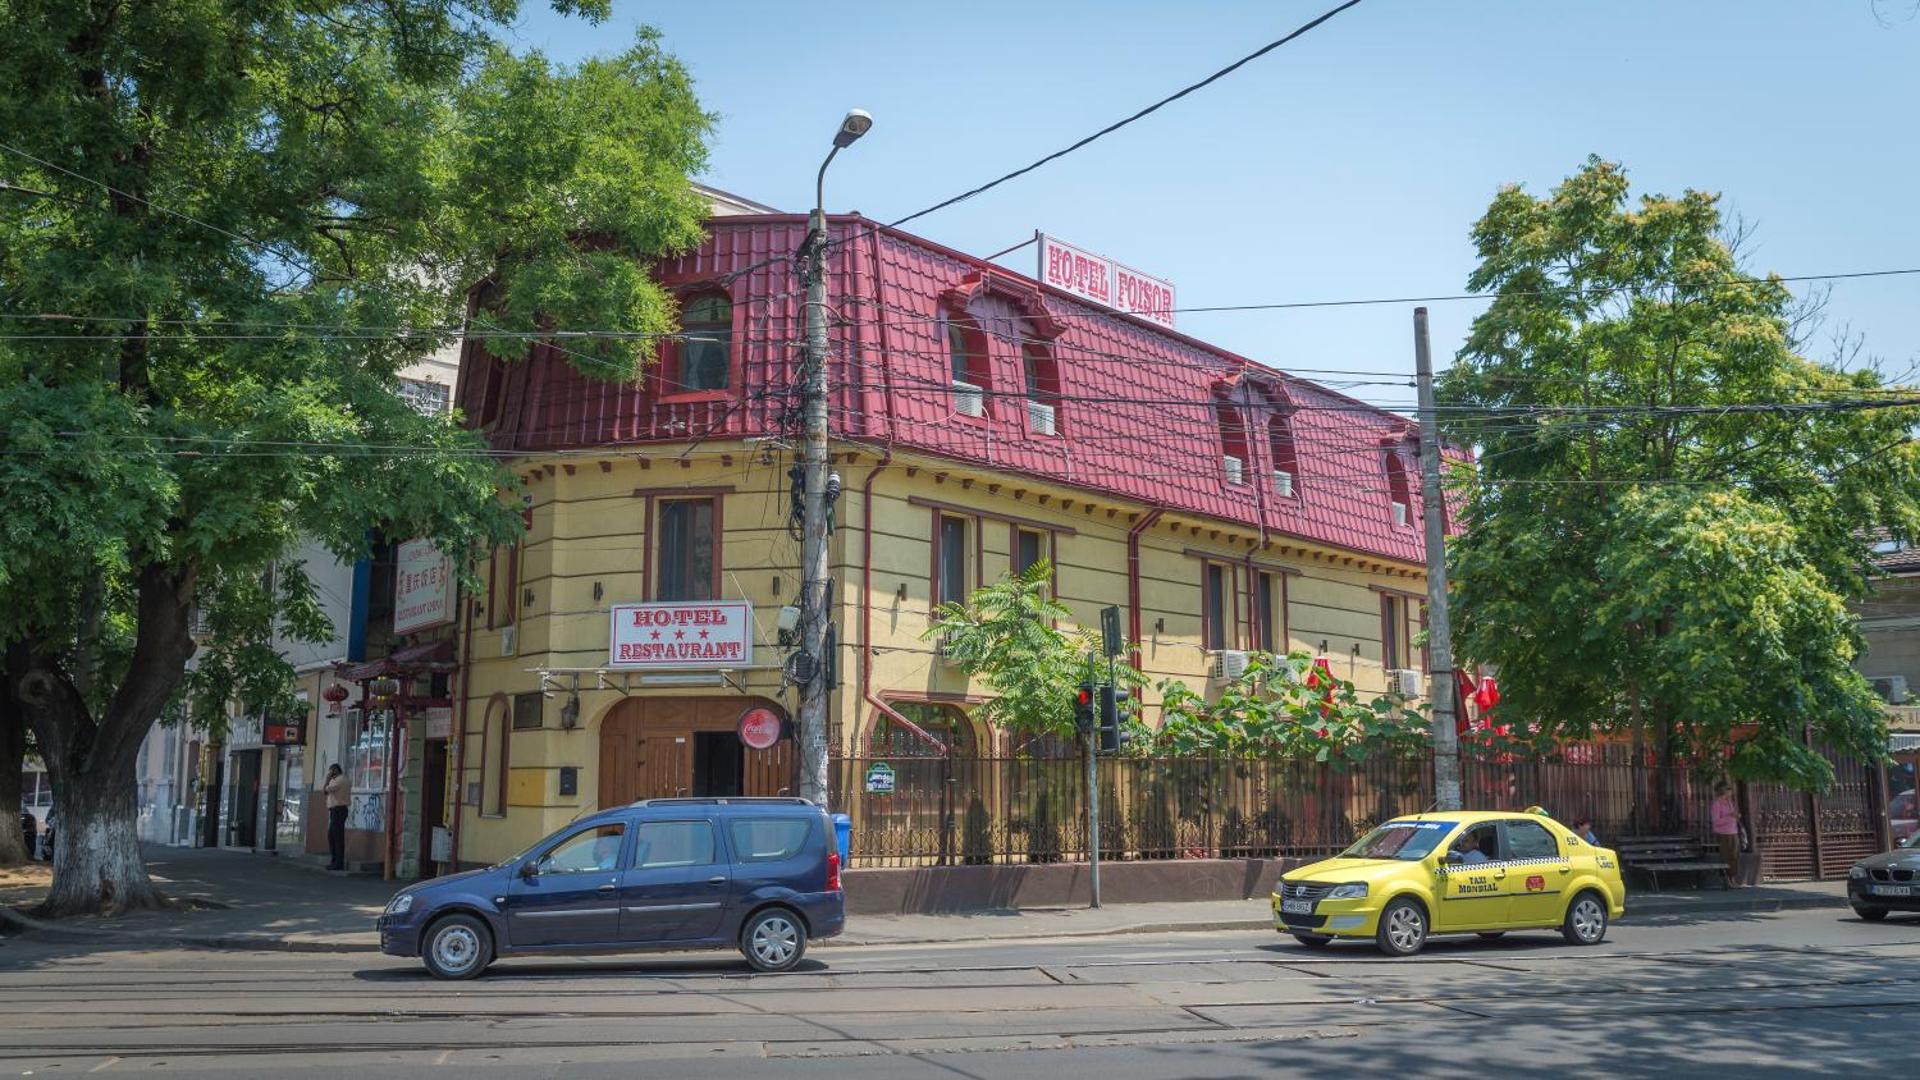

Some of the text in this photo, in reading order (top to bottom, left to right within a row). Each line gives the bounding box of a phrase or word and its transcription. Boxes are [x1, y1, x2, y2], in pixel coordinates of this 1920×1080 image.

[1048, 244, 1172, 324] HOTEL FOISOR
[633, 609, 727, 627] HOTEL
[619, 641, 741, 660] RESTAURANT
[1458, 883, 1498, 894] MONDIAL
[1469, 876, 1487, 885] TAXI
